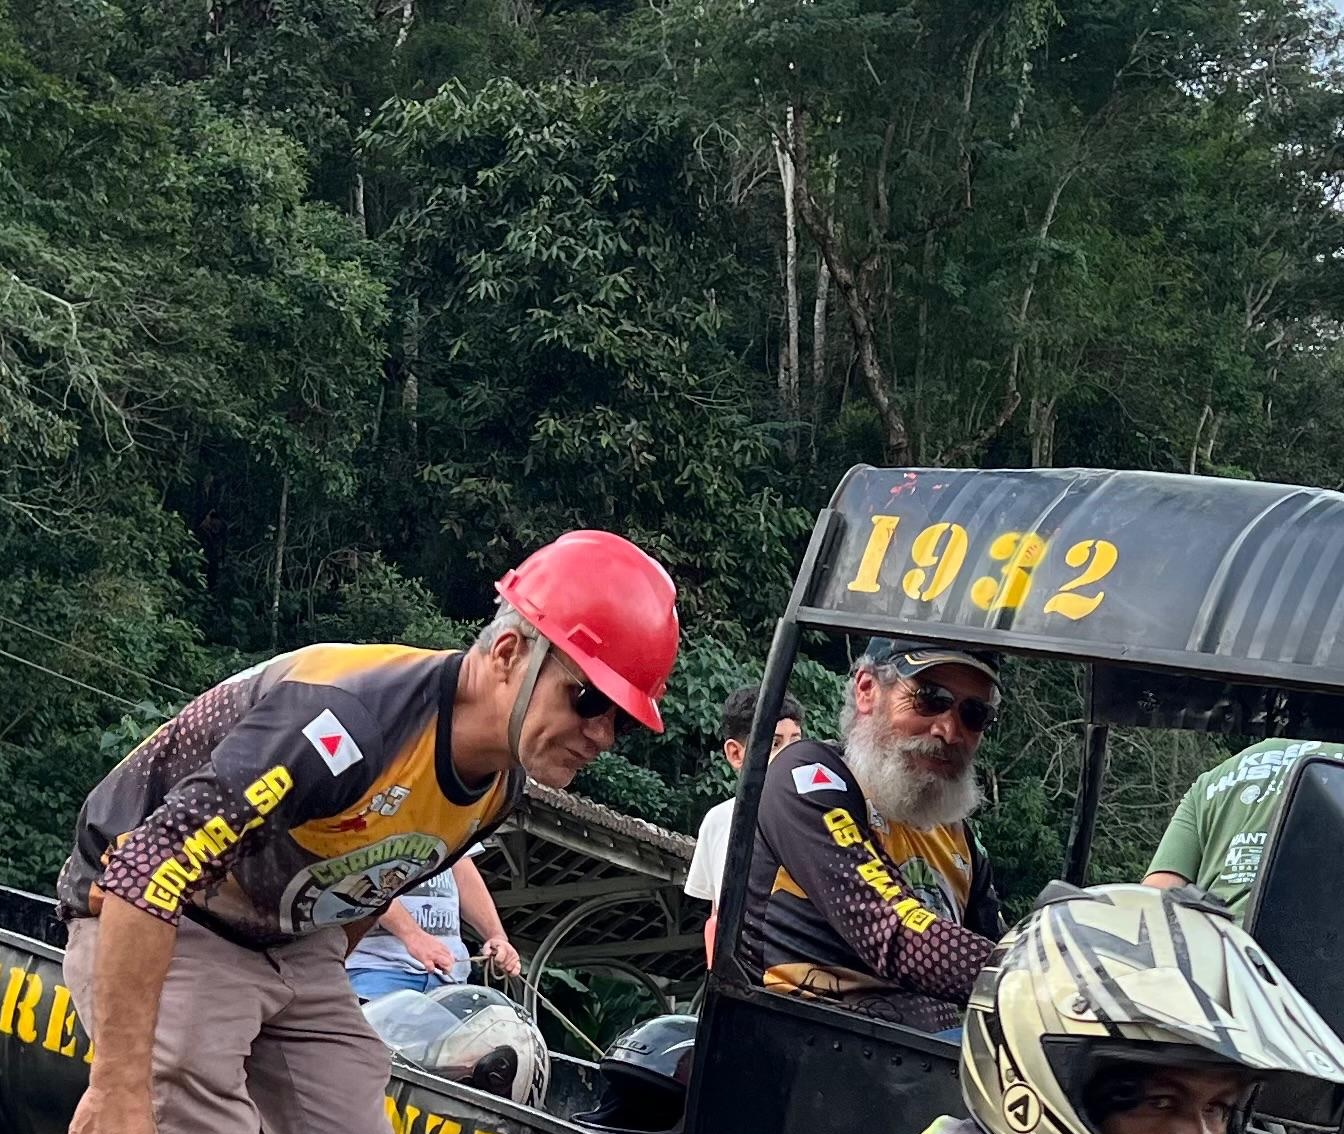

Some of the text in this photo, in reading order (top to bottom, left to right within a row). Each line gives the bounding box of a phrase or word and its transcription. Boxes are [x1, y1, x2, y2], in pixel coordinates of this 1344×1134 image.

[847, 515, 1119, 621] 1932
[1238, 740, 1322, 769] KEEP
[308, 834, 441, 887] CARRINHO
